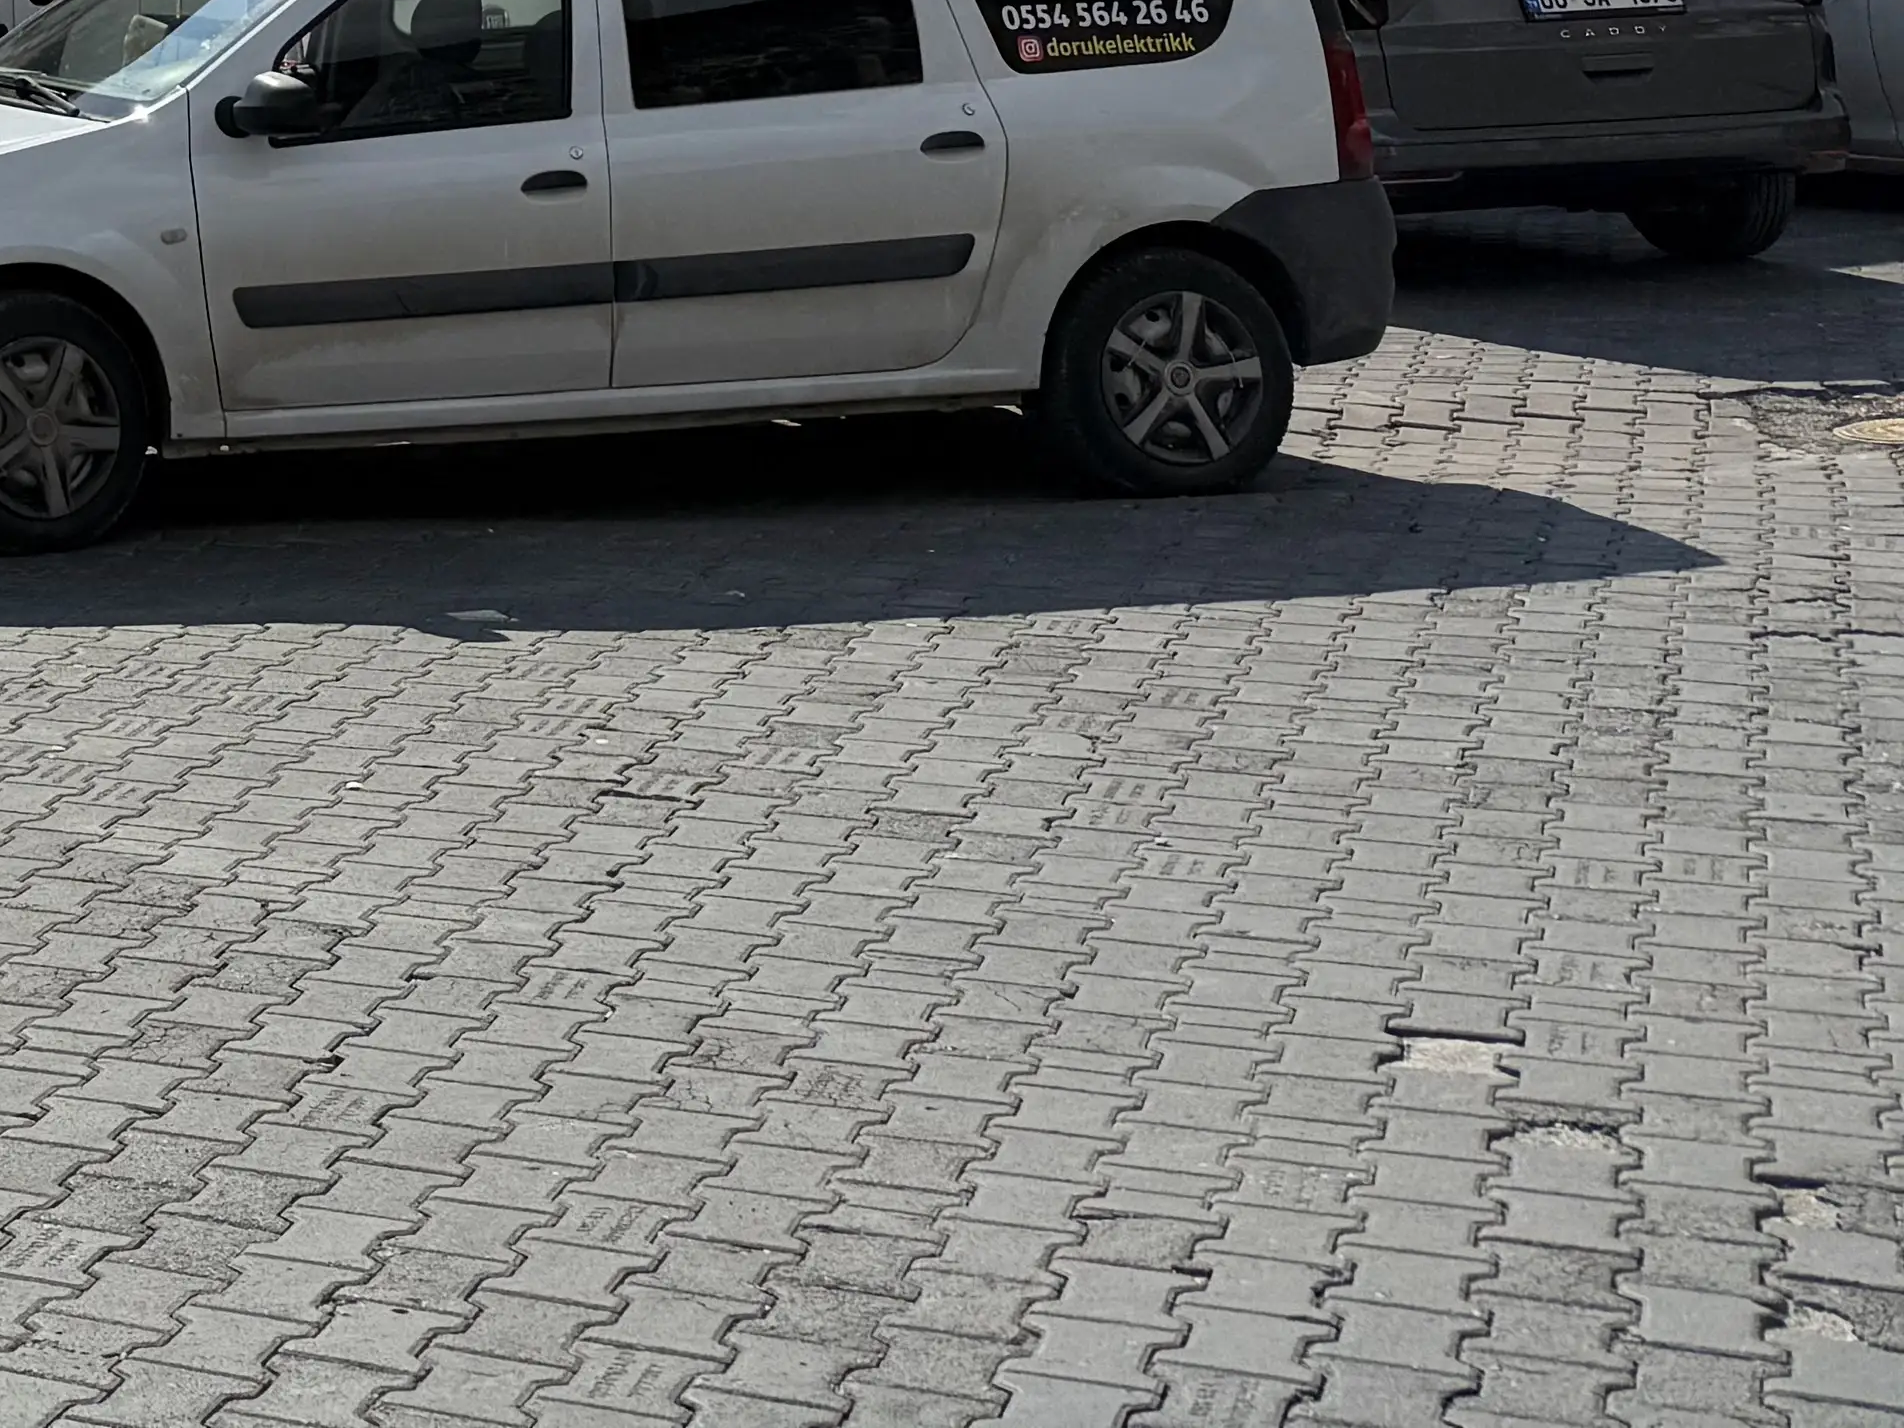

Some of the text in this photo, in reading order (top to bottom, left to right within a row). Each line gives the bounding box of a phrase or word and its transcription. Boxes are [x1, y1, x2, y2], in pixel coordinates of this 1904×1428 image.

[1001, 0, 1070, 30] 0554
[1075, 0, 1128, 28] 564
[1046, 31, 1196, 58] dorukelektrikk
